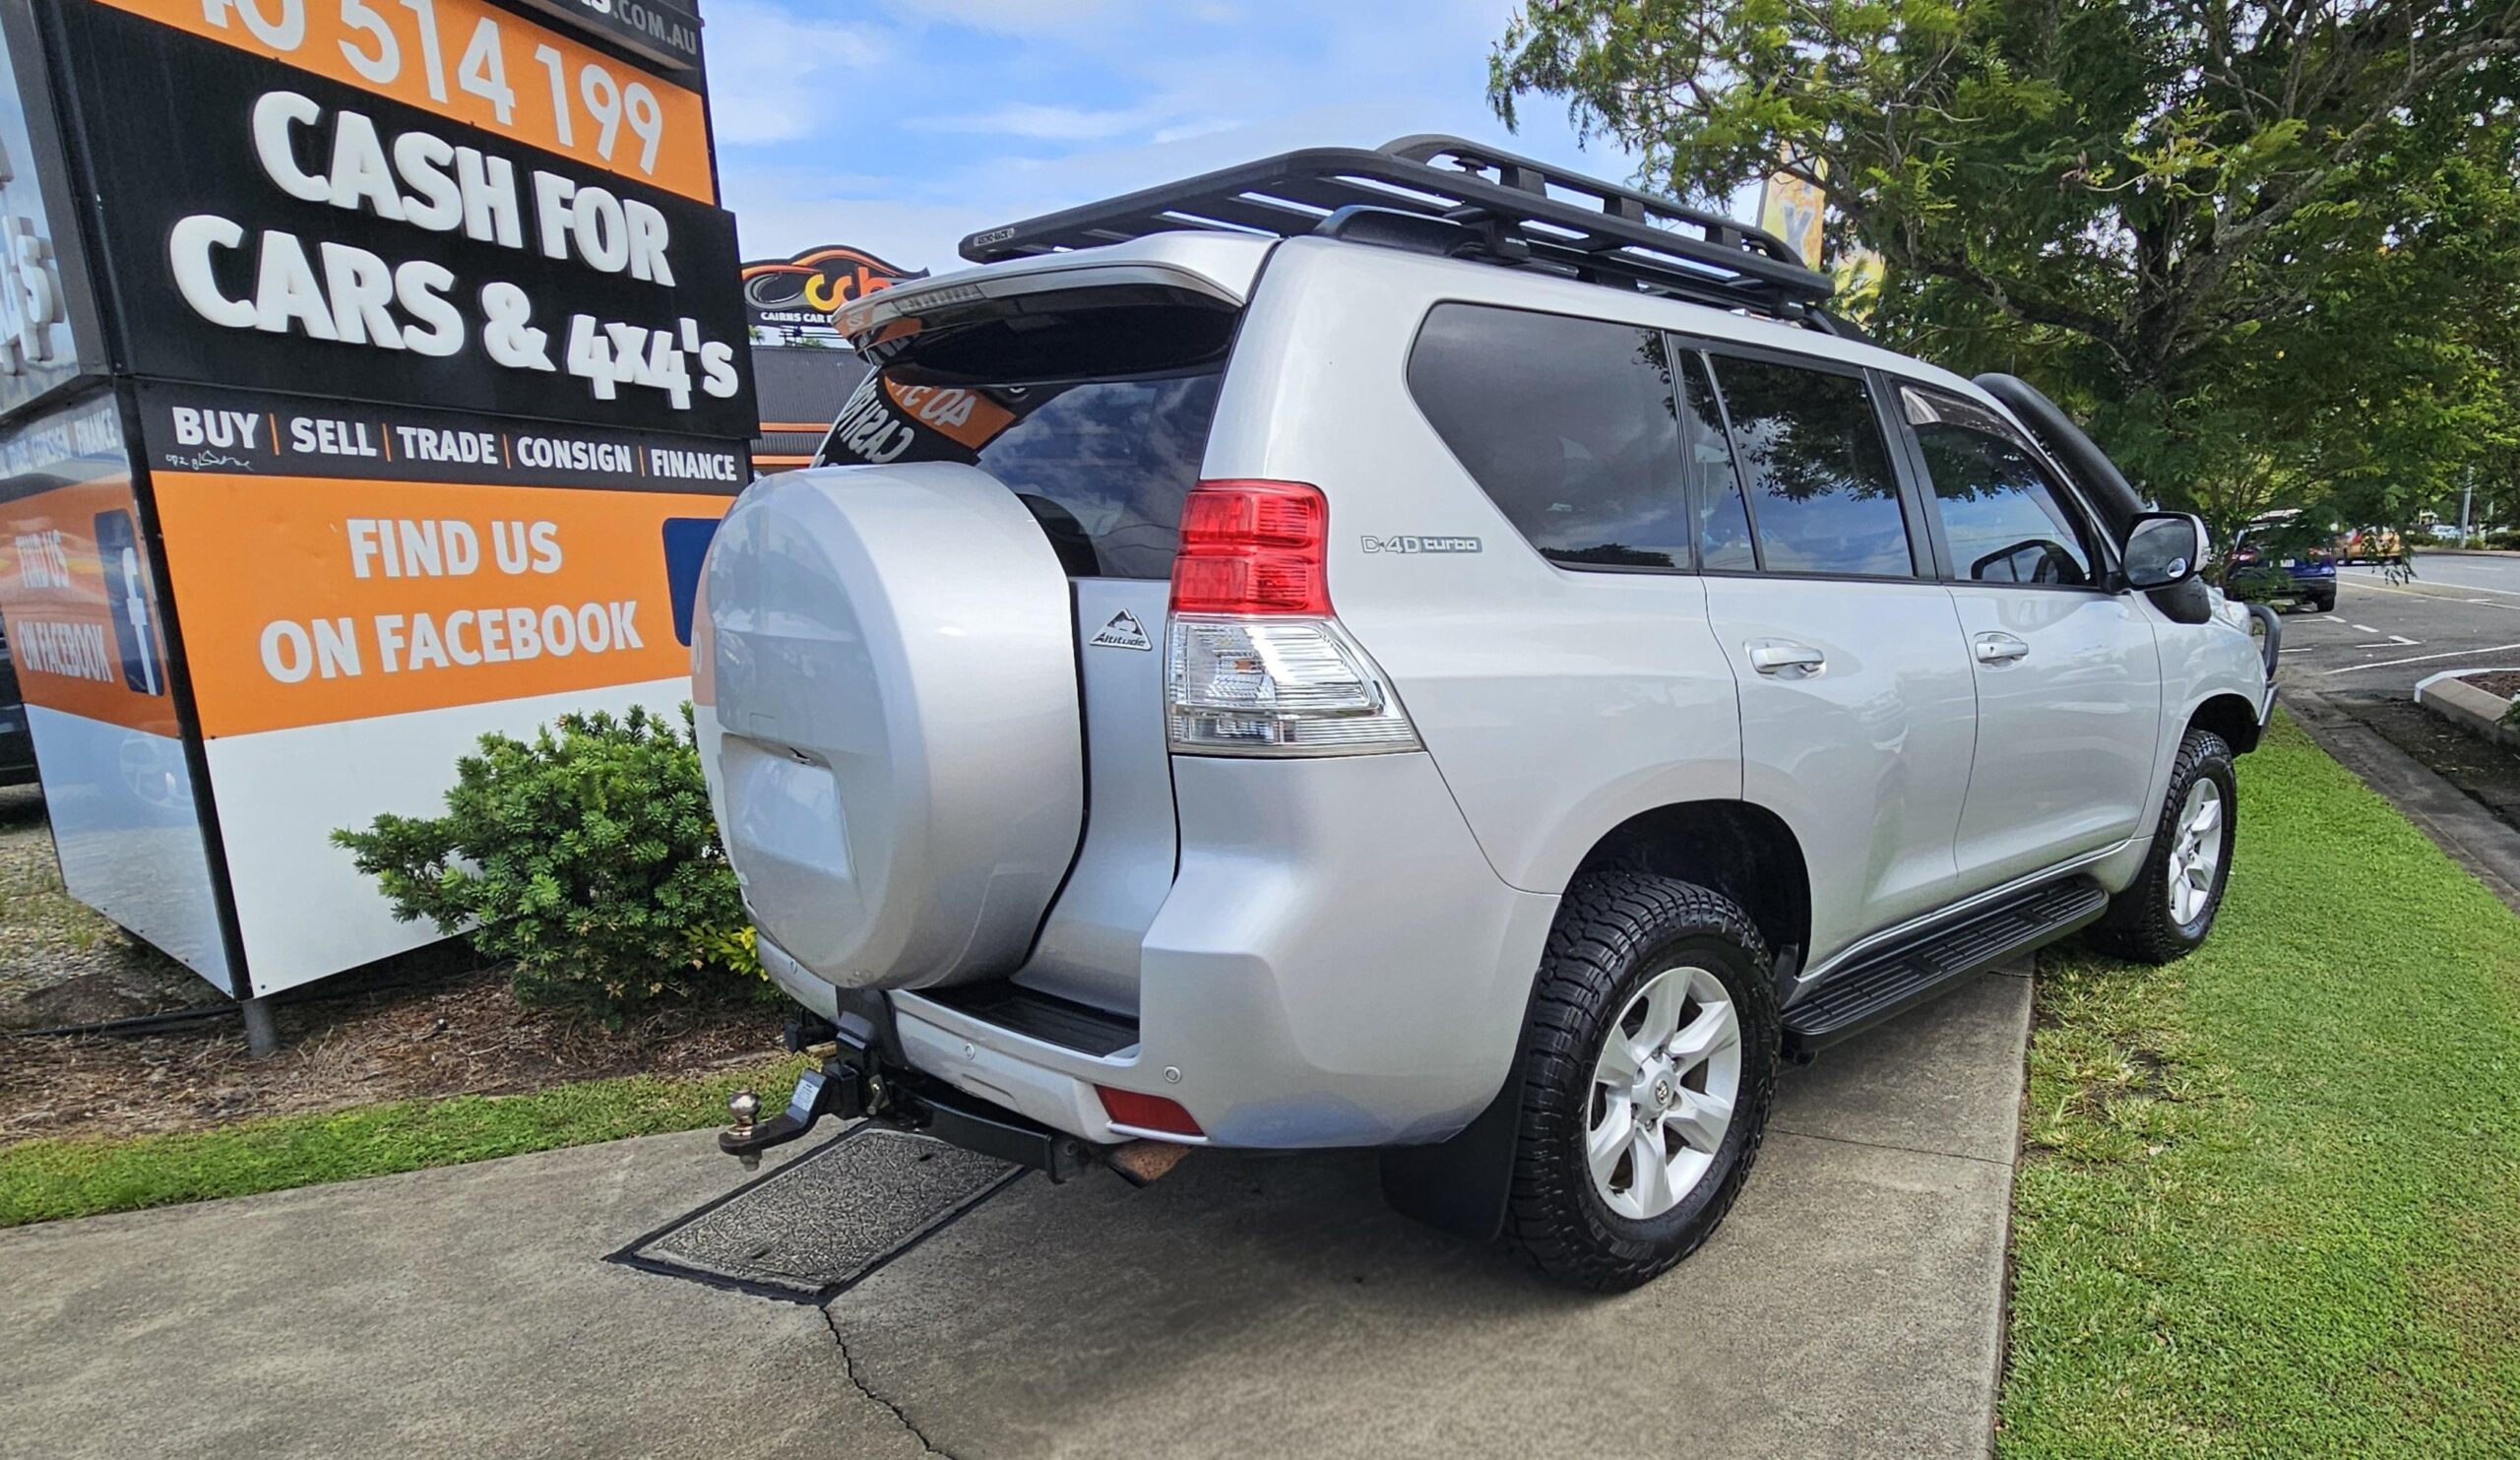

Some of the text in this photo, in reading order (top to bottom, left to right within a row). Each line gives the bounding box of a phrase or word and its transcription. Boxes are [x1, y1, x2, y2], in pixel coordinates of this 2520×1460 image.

[202, 0, 662, 175] 0 514 199
[253, 91, 676, 287] CASH FOR
[169, 215, 465, 357] CARS
[481, 282, 557, 372] &
[761, 311, 802, 323] CAIRNS
[802, 313, 826, 324] CAR
[171, 407, 738, 482] BUY SELL TRADE CONSIGN FINANCE
[346, 518, 564, 579] FIND US
[1361, 535, 1478, 554] D-4D turbo
[17, 620, 114, 682] ON FACEBOOK
[259, 600, 644, 683] ON FACEBOOK
[1092, 631, 1147, 647] Altitude
